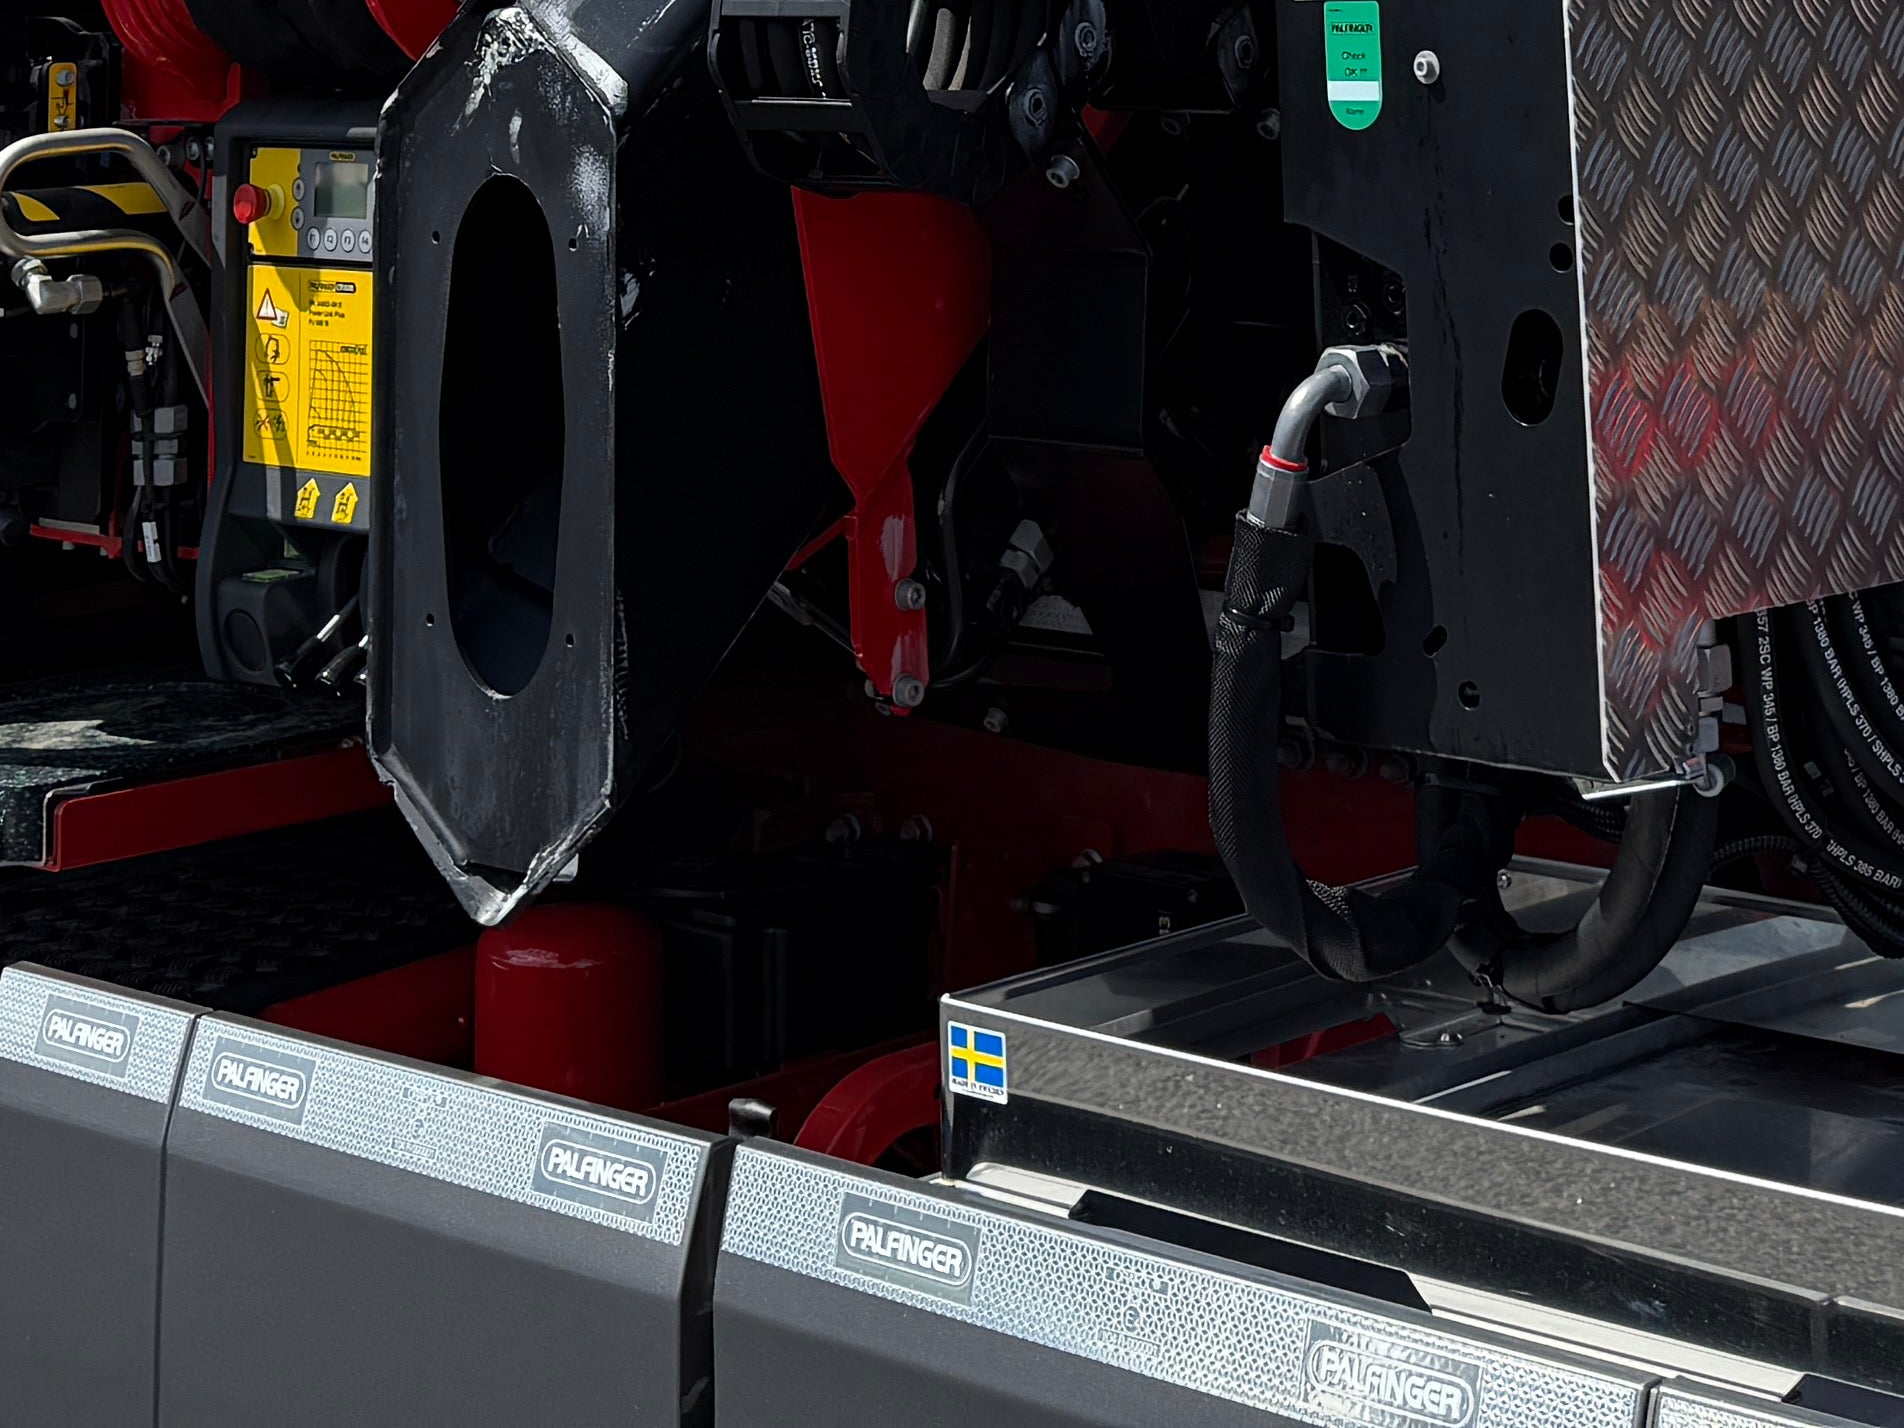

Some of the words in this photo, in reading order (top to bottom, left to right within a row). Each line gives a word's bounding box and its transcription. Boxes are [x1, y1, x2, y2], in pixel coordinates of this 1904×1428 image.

[1870, 655, 1885, 676] BP
[1824, 647, 1843, 679] BAR
[1855, 714, 1873, 739] 370
[1777, 771, 1795, 797] BAR
[47, 1015, 125, 1056] PALFINGER
[217, 1058, 300, 1102] PALFINGER
[547, 1146, 649, 1196] PALFINGER
[849, 1219, 964, 1278] PALFINGER
[1317, 1349, 1463, 1420] PALFINGER
